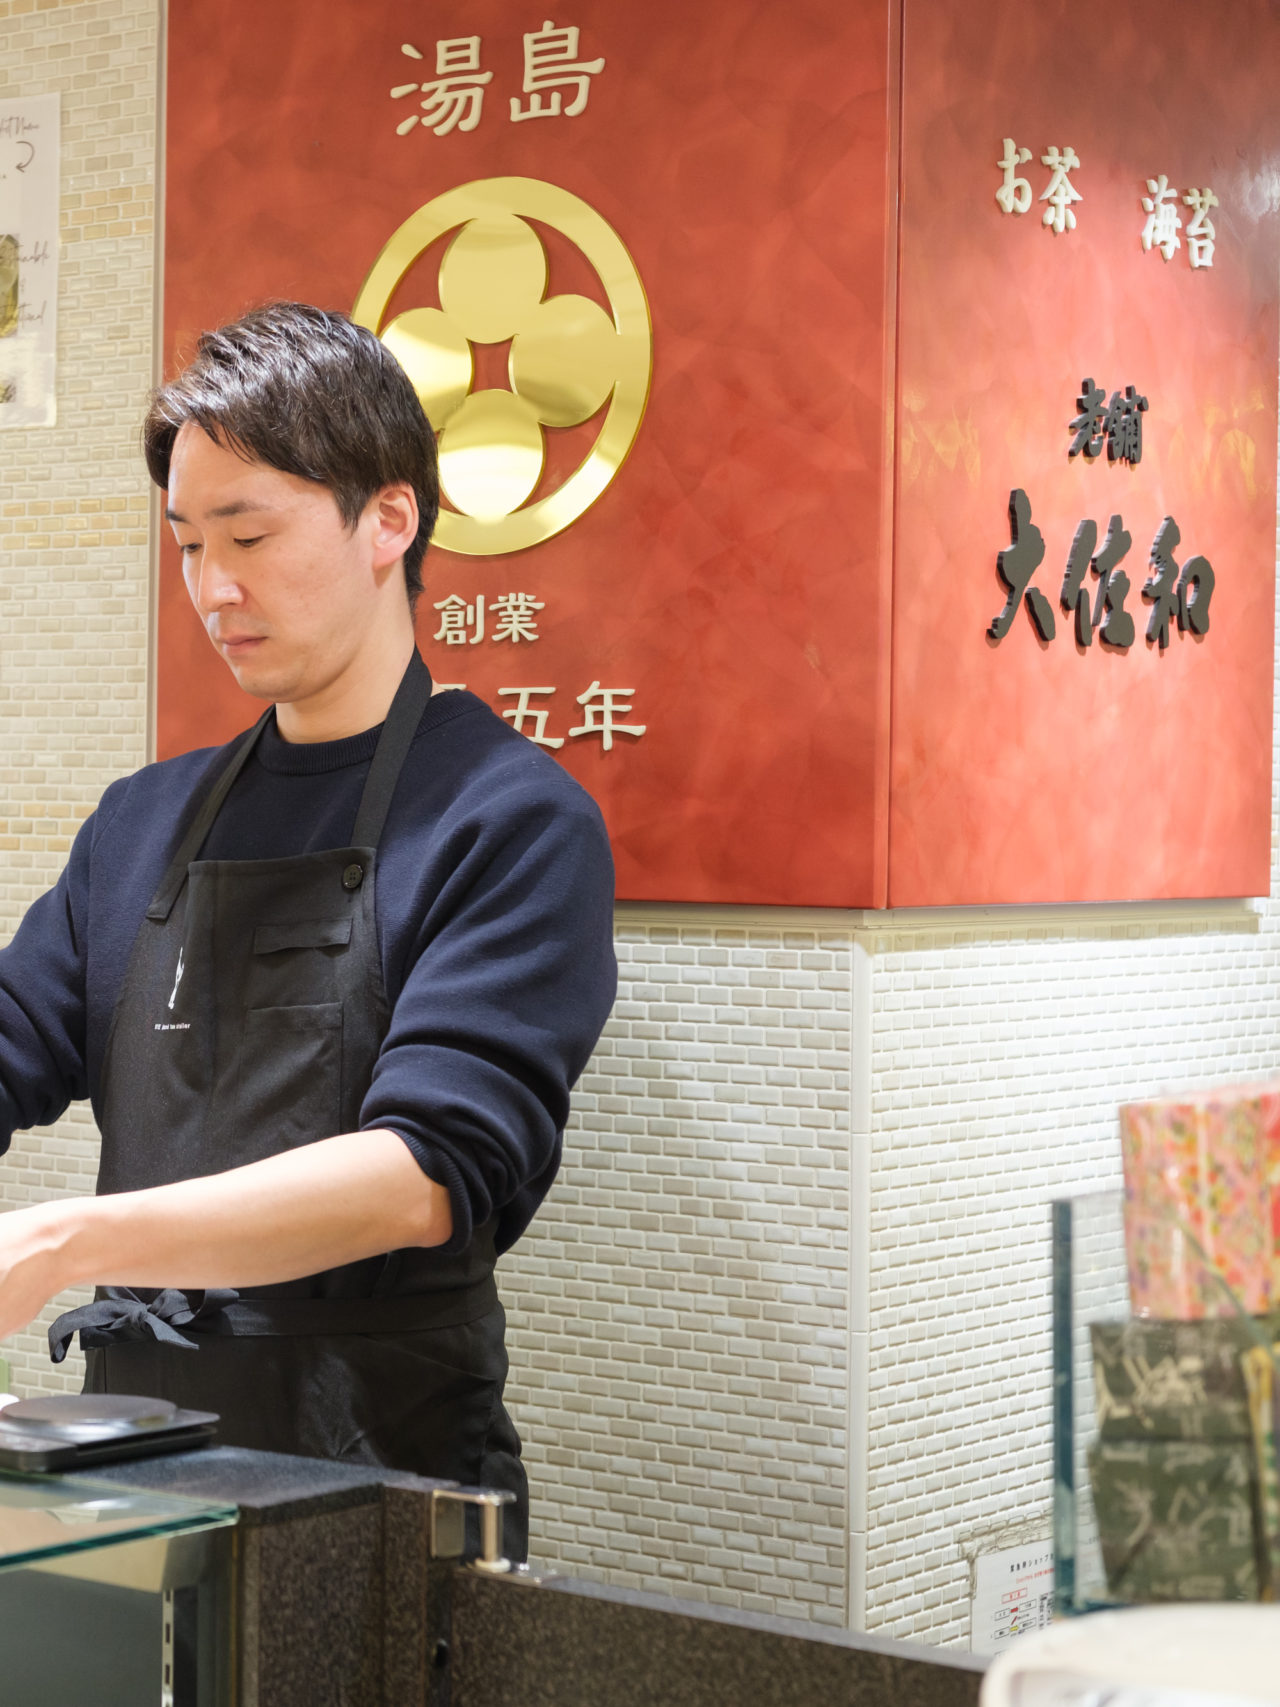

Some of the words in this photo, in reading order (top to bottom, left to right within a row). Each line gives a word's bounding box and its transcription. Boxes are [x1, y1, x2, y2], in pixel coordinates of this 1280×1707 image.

[389, 20, 606, 137] 湯島
[995, 137, 1083, 234] お茶
[1141, 173, 1220, 269] 海苔
[1068, 377, 1149, 466] 老舗
[986, 487, 1217, 649] 大佐和
[432, 592, 546, 645] 創業
